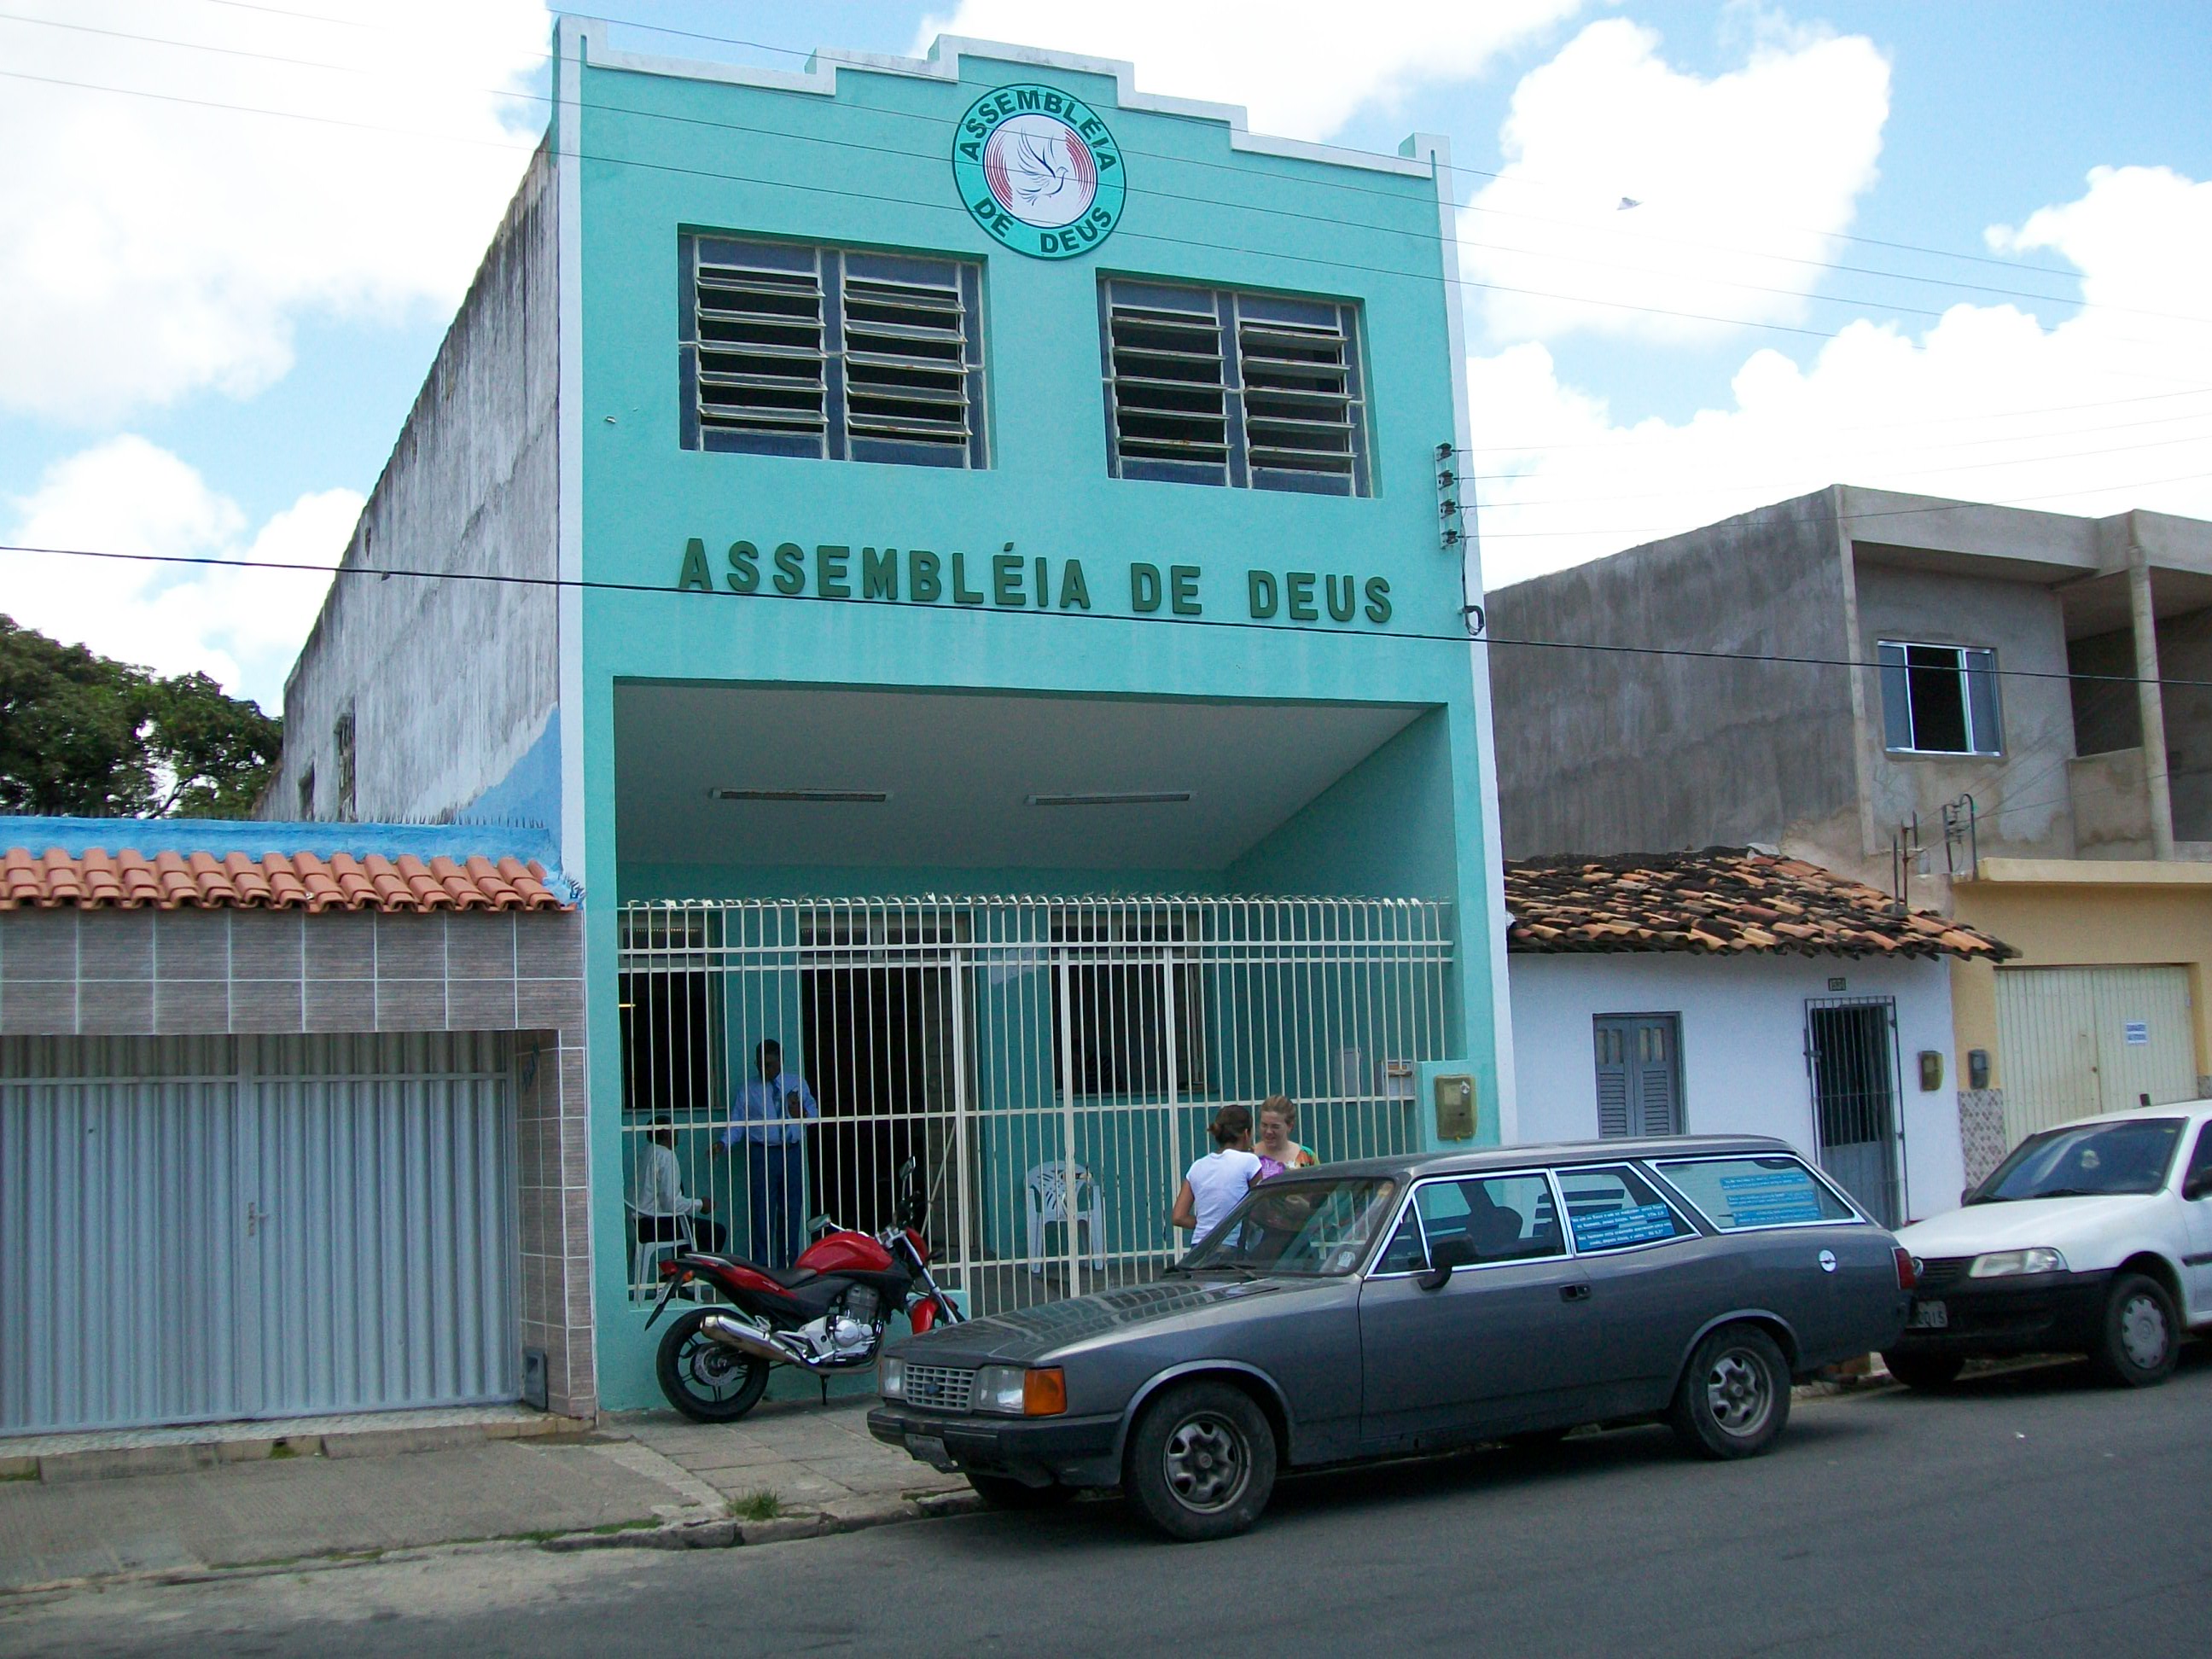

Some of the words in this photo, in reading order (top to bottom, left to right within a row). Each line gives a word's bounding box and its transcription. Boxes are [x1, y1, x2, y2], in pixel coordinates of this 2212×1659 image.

[973, 197, 1014, 238] DE
[1040, 207, 1112, 253] DEUS
[679, 537, 1091, 609] ASSEMBLÉIA
[1131, 562, 1202, 614] DE
[1248, 569, 1393, 623] DEUS
